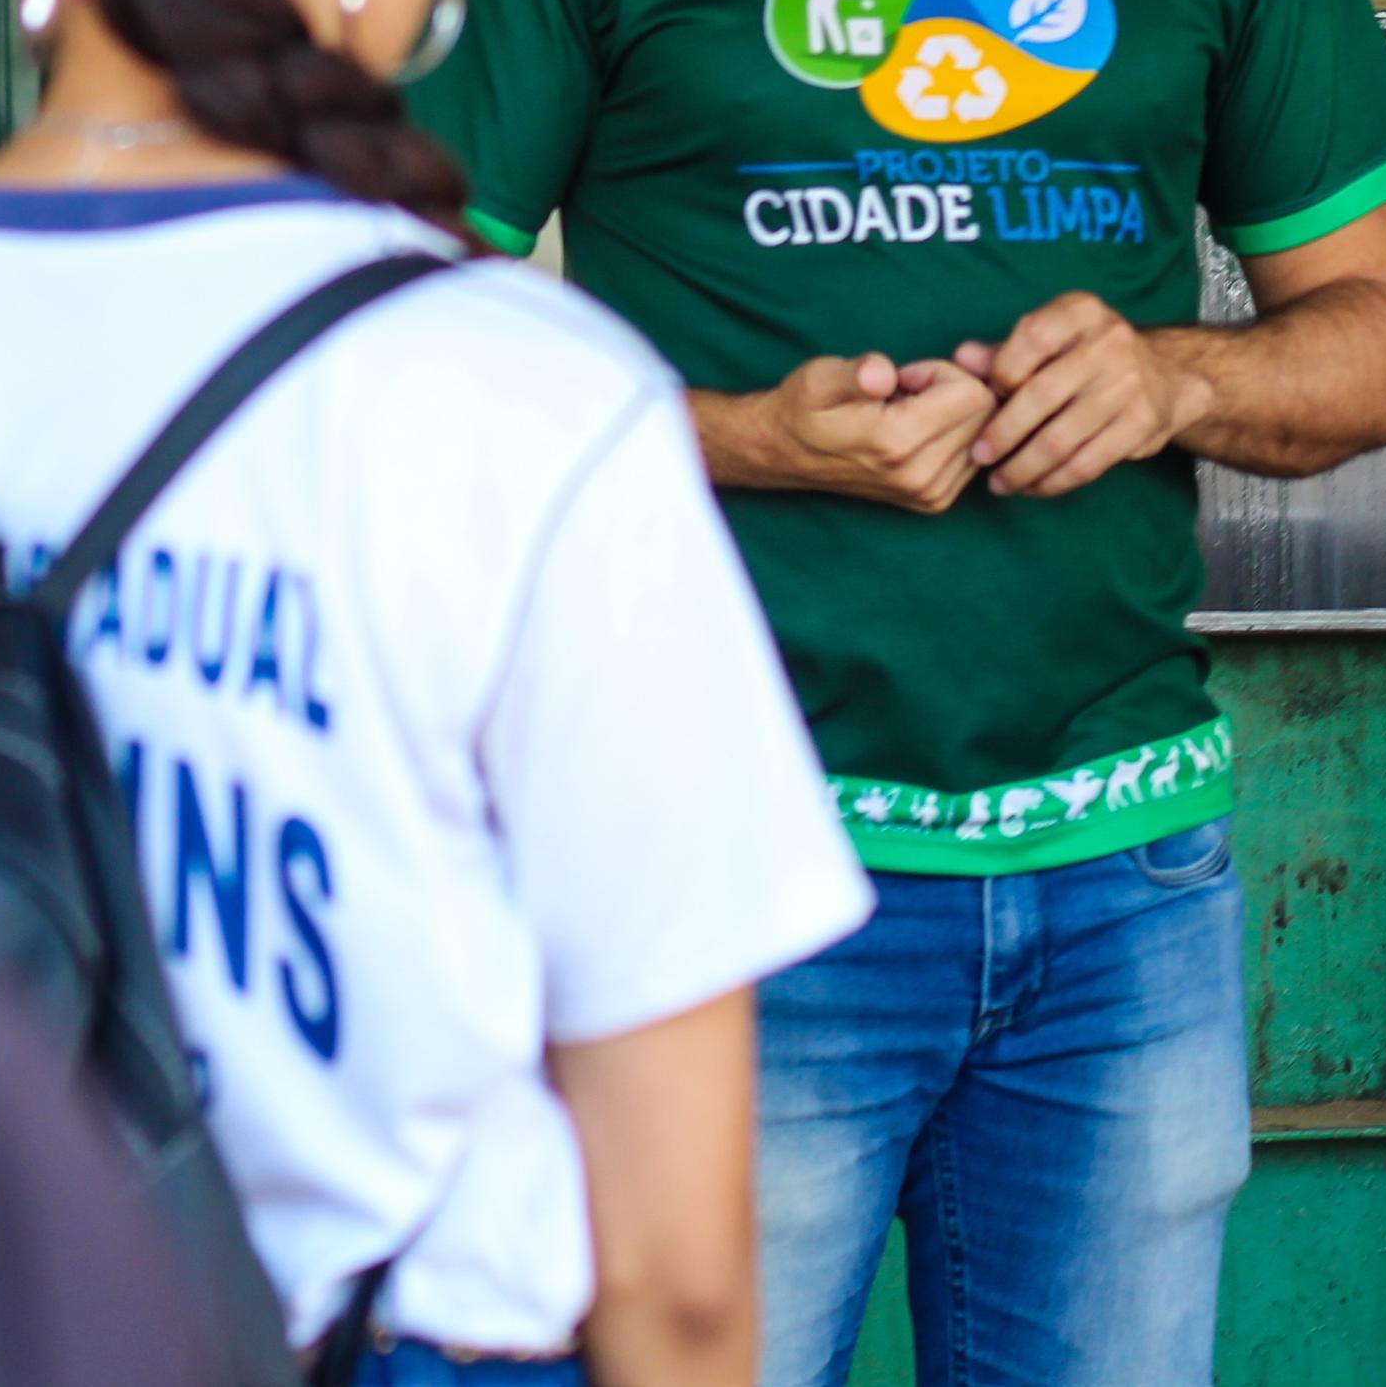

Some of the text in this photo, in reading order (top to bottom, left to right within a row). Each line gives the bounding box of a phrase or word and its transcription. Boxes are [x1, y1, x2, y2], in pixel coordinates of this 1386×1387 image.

[856, 150, 1050, 184] PROJETO
[743, 184, 1145, 247] CIDADE LIMPA
